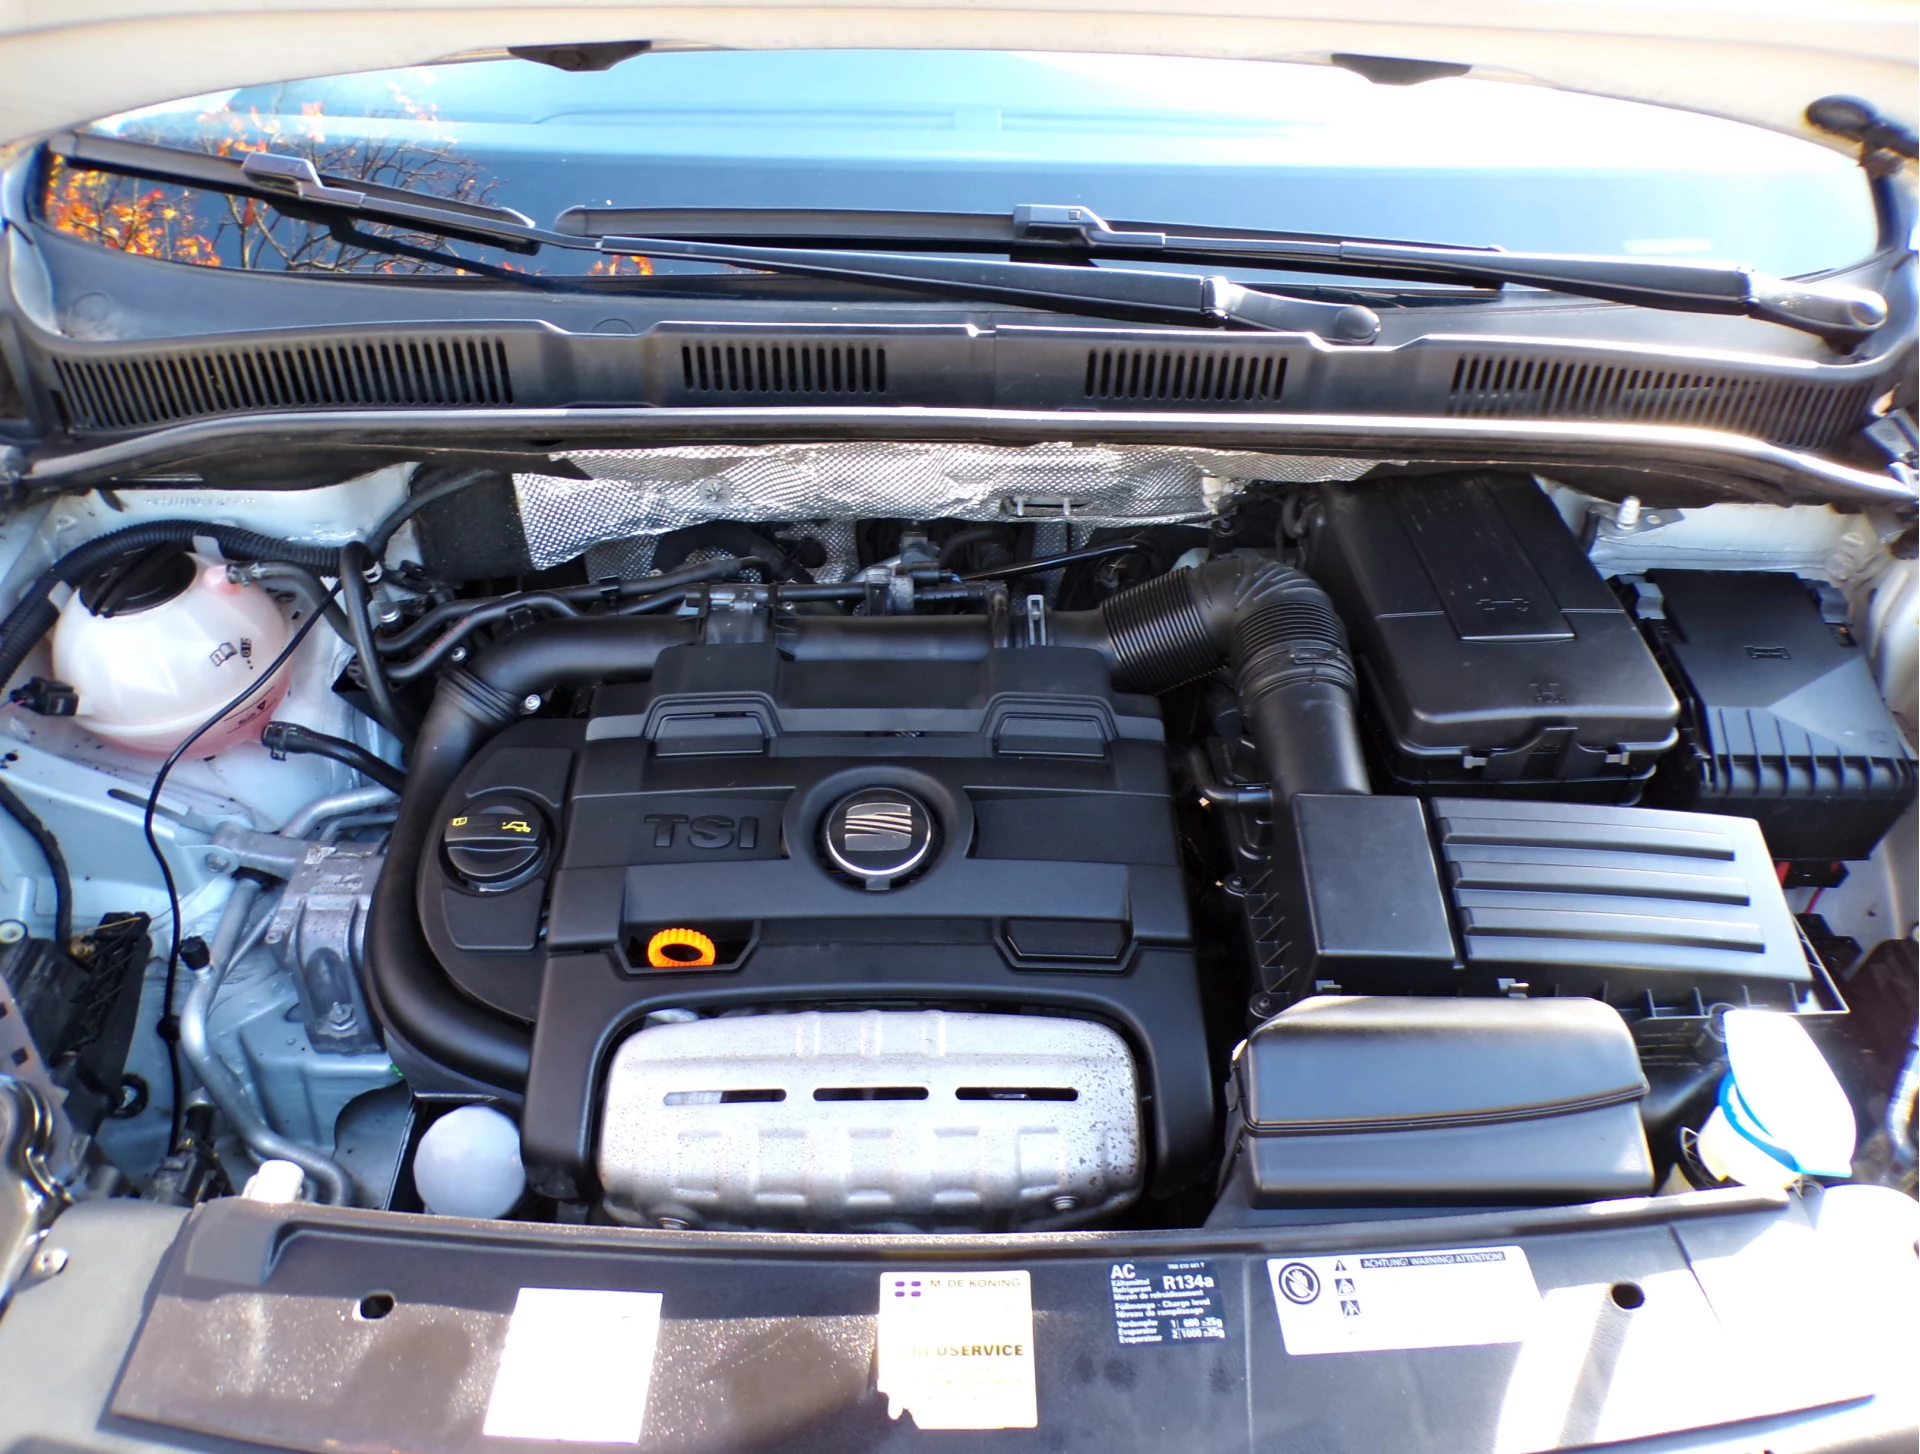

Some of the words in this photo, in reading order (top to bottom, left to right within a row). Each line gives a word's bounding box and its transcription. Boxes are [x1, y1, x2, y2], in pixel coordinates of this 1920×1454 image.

[643, 813, 759, 849] TSI
[1363, 1257, 1408, 1268] ACHTUNG!
[1409, 1254, 1455, 1266] WARNING!
[1454, 1251, 1504, 1264] ATTENTION!
[1110, 1263, 1136, 1279] AC
[930, 1279, 941, 1287] M
[947, 1279, 964, 1287] DE
[969, 1278, 1021, 1287] KONING
[1162, 1274, 1215, 1290] R134a
[1112, 1286, 1152, 1294] Refrigerant
[1139, 1292, 1149, 1300] de
[1162, 1299, 1191, 1308] Charge
[1191, 1298, 1211, 1306] level
[1116, 1311, 1144, 1319] Niveau
[1145, 1309, 1156, 1317] de
[1171, 1329, 1179, 1339] 2
[1181, 1328, 1202, 1338] 1000
